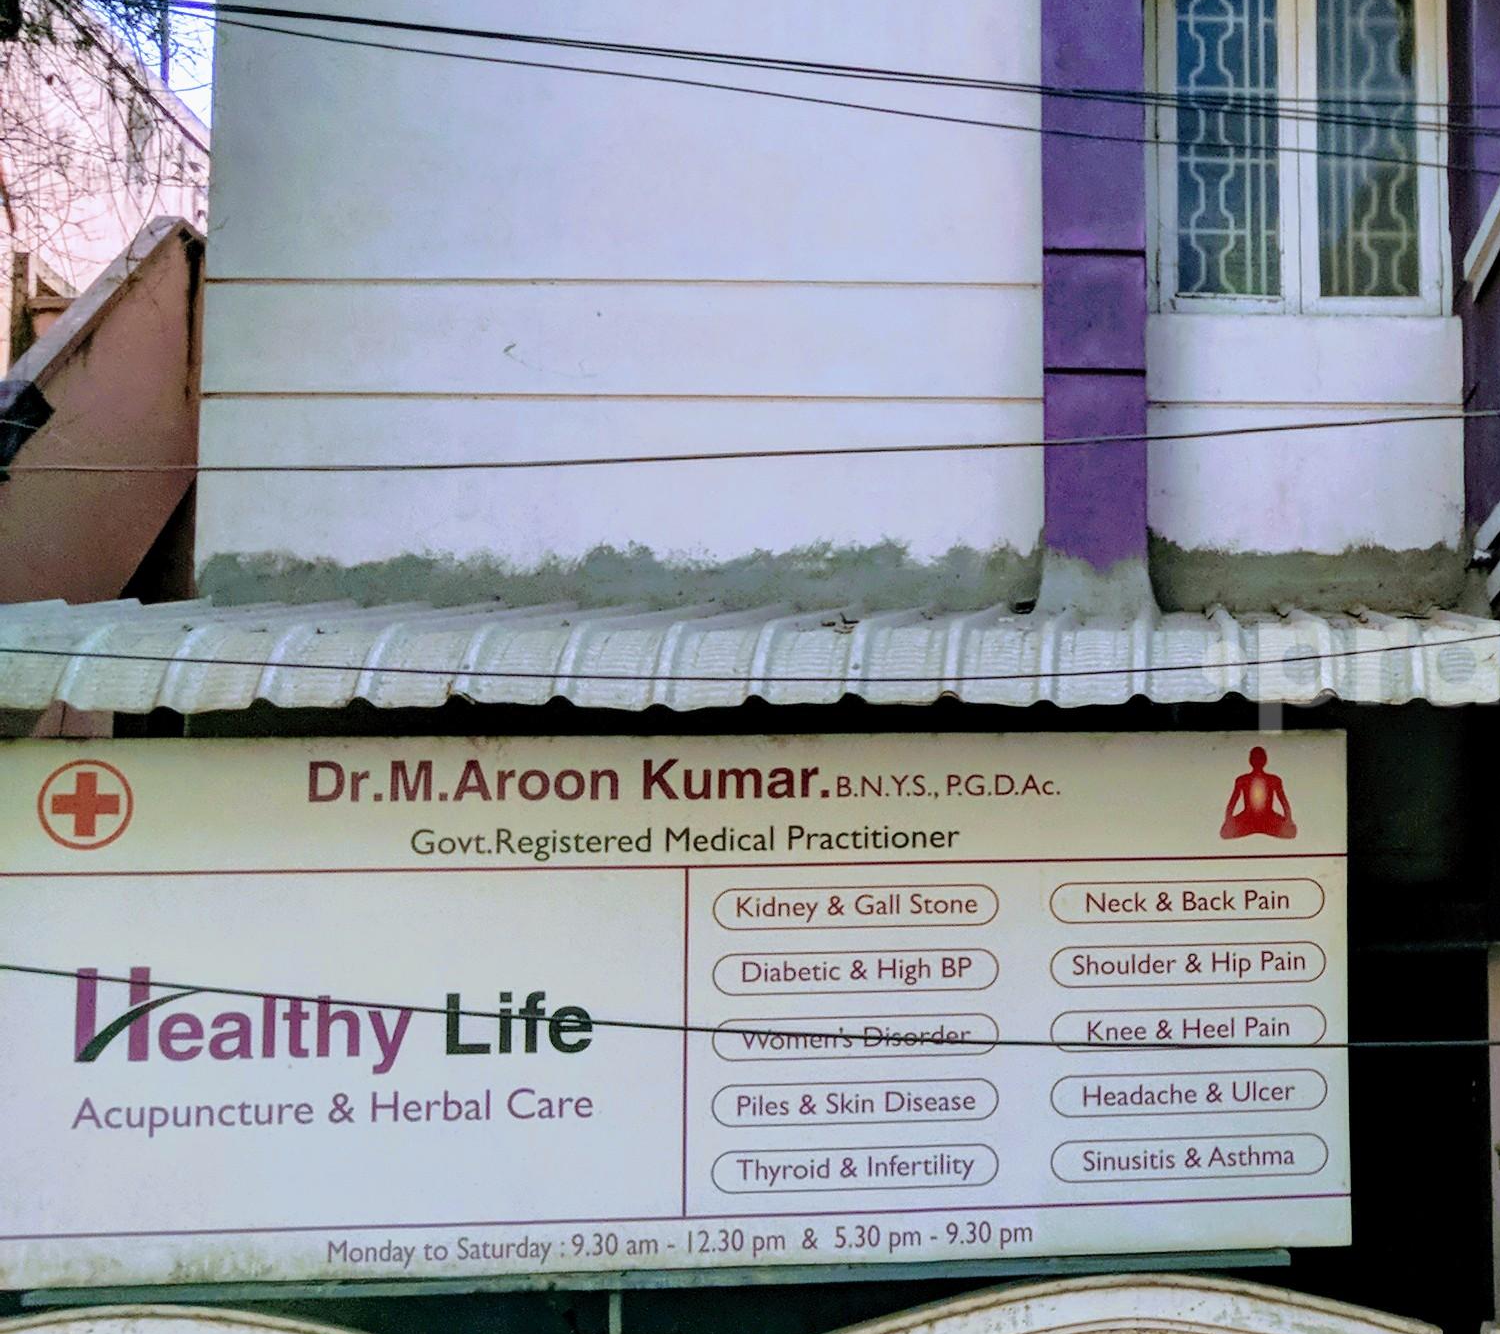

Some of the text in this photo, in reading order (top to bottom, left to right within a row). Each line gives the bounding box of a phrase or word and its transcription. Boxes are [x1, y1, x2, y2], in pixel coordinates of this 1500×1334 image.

[309, 759, 618, 802] Dr.M.Aroon
[643, 759, 829, 800] Kumar.
[947, 774, 1060, 796] P.G.D.Ac.
[411, 825, 959, 862] Govt.Registered Medical Practitioner
[737, 894, 977, 921] Kidney & Gall Stone
[1086, 890, 1289, 913] Neck & Back Pain
[742, 957, 972, 985] Diabetic & High BP
[1073, 951, 1305, 978] Shoulder & Hip Pain
[74, 967, 593, 1075] Healthy Life
[1087, 1017, 1289, 1041] Knee & Heel Pain
[741, 1026, 971, 1050] Women's Disorder
[738, 1091, 975, 1116] Piles & Skin Disease
[1084, 1081, 1295, 1107] Headache & Ulcer
[72, 1088, 593, 1138] Acupuncture & Herbal Care
[736, 1155, 974, 1185] Thyroid & Infertility
[1084, 1145, 1294, 1171] Sinusitis & Asthma
[327, 1239, 415, 1268] Monday
[424, 1244, 448, 1261] to
[457, 1235, 552, 1264] Saturday
[572, 1233, 618, 1256] 9.30
[627, 1239, 658, 1255] am
[688, 1229, 744, 1254] 12.30
[753, 1235, 785, 1259] pm
[802, 1228, 818, 1250] &
[835, 1225, 880, 1248] 5.30
[889, 1231, 921, 1254] pm
[946, 1221, 991, 1244] 9.30
[1000, 1227, 1032, 1249] pm
